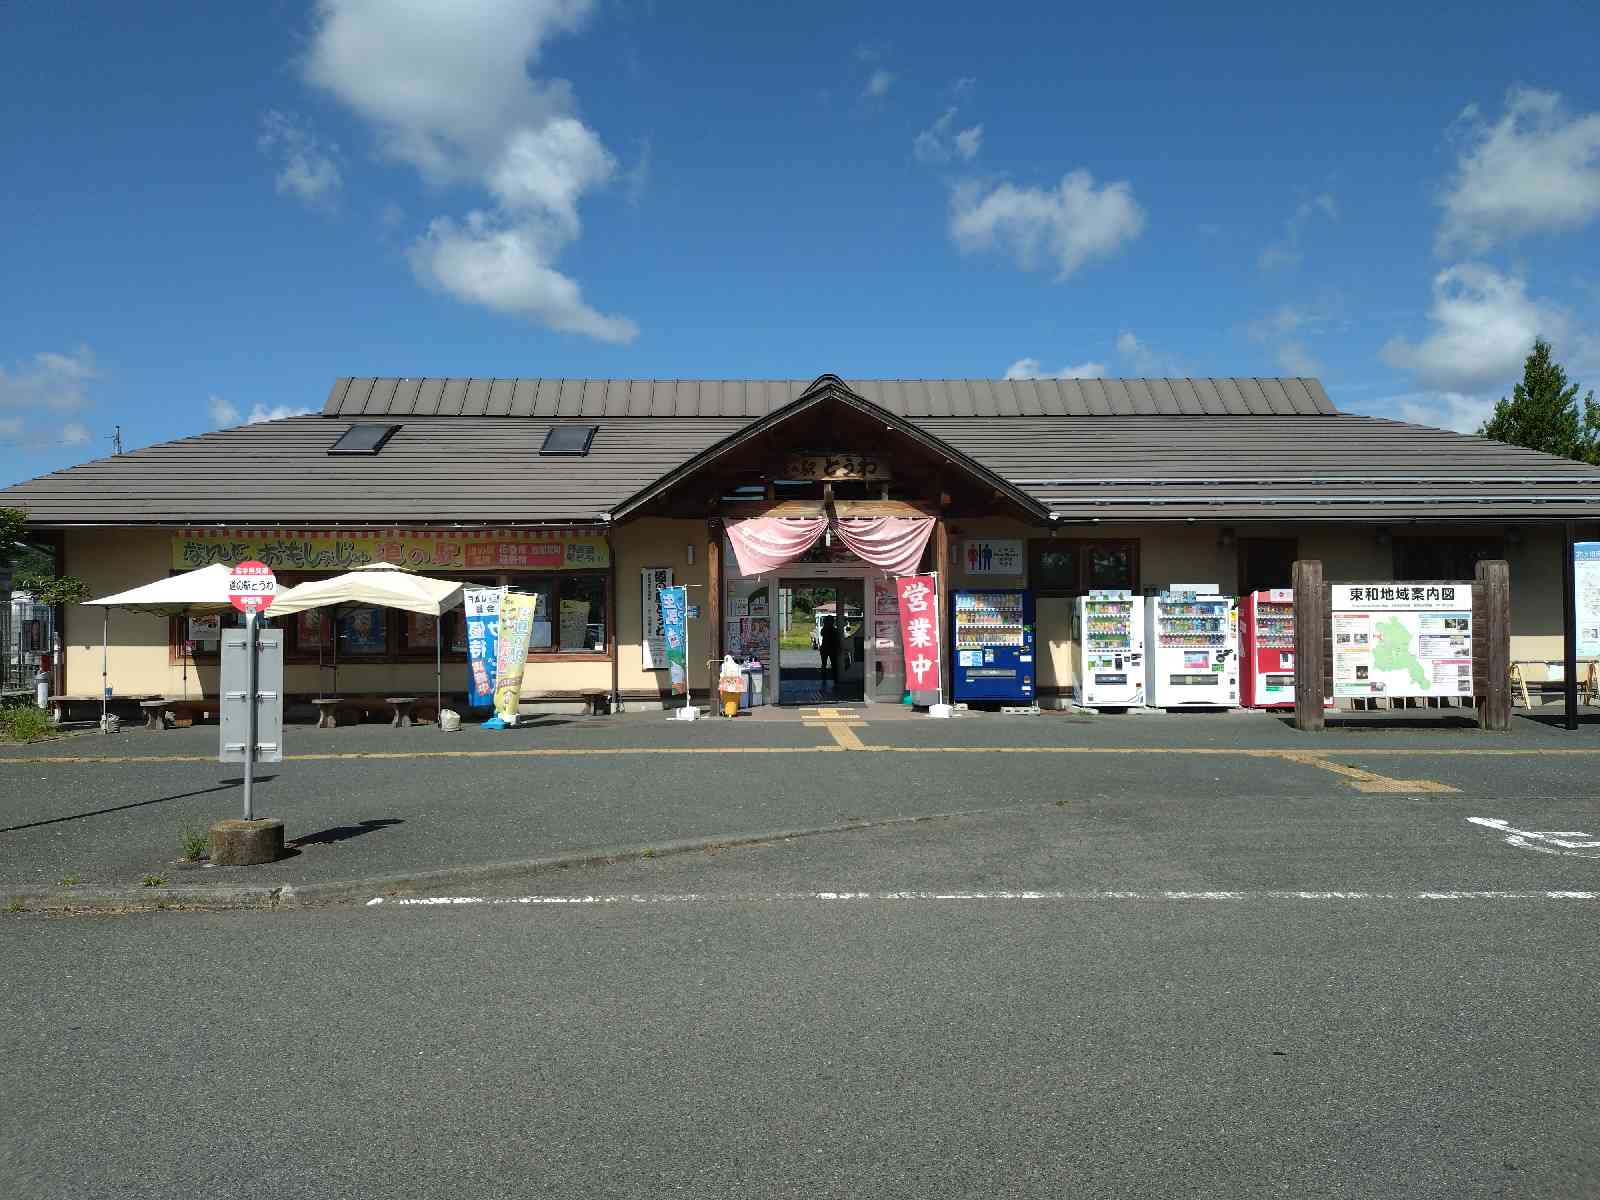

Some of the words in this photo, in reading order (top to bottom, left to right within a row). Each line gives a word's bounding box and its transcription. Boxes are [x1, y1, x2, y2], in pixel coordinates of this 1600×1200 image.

[229, 579, 274, 591] 道の駅とうわ
[1349, 587, 1455, 601] 東和地域案内図
[902, 582, 933, 685] 営業中
